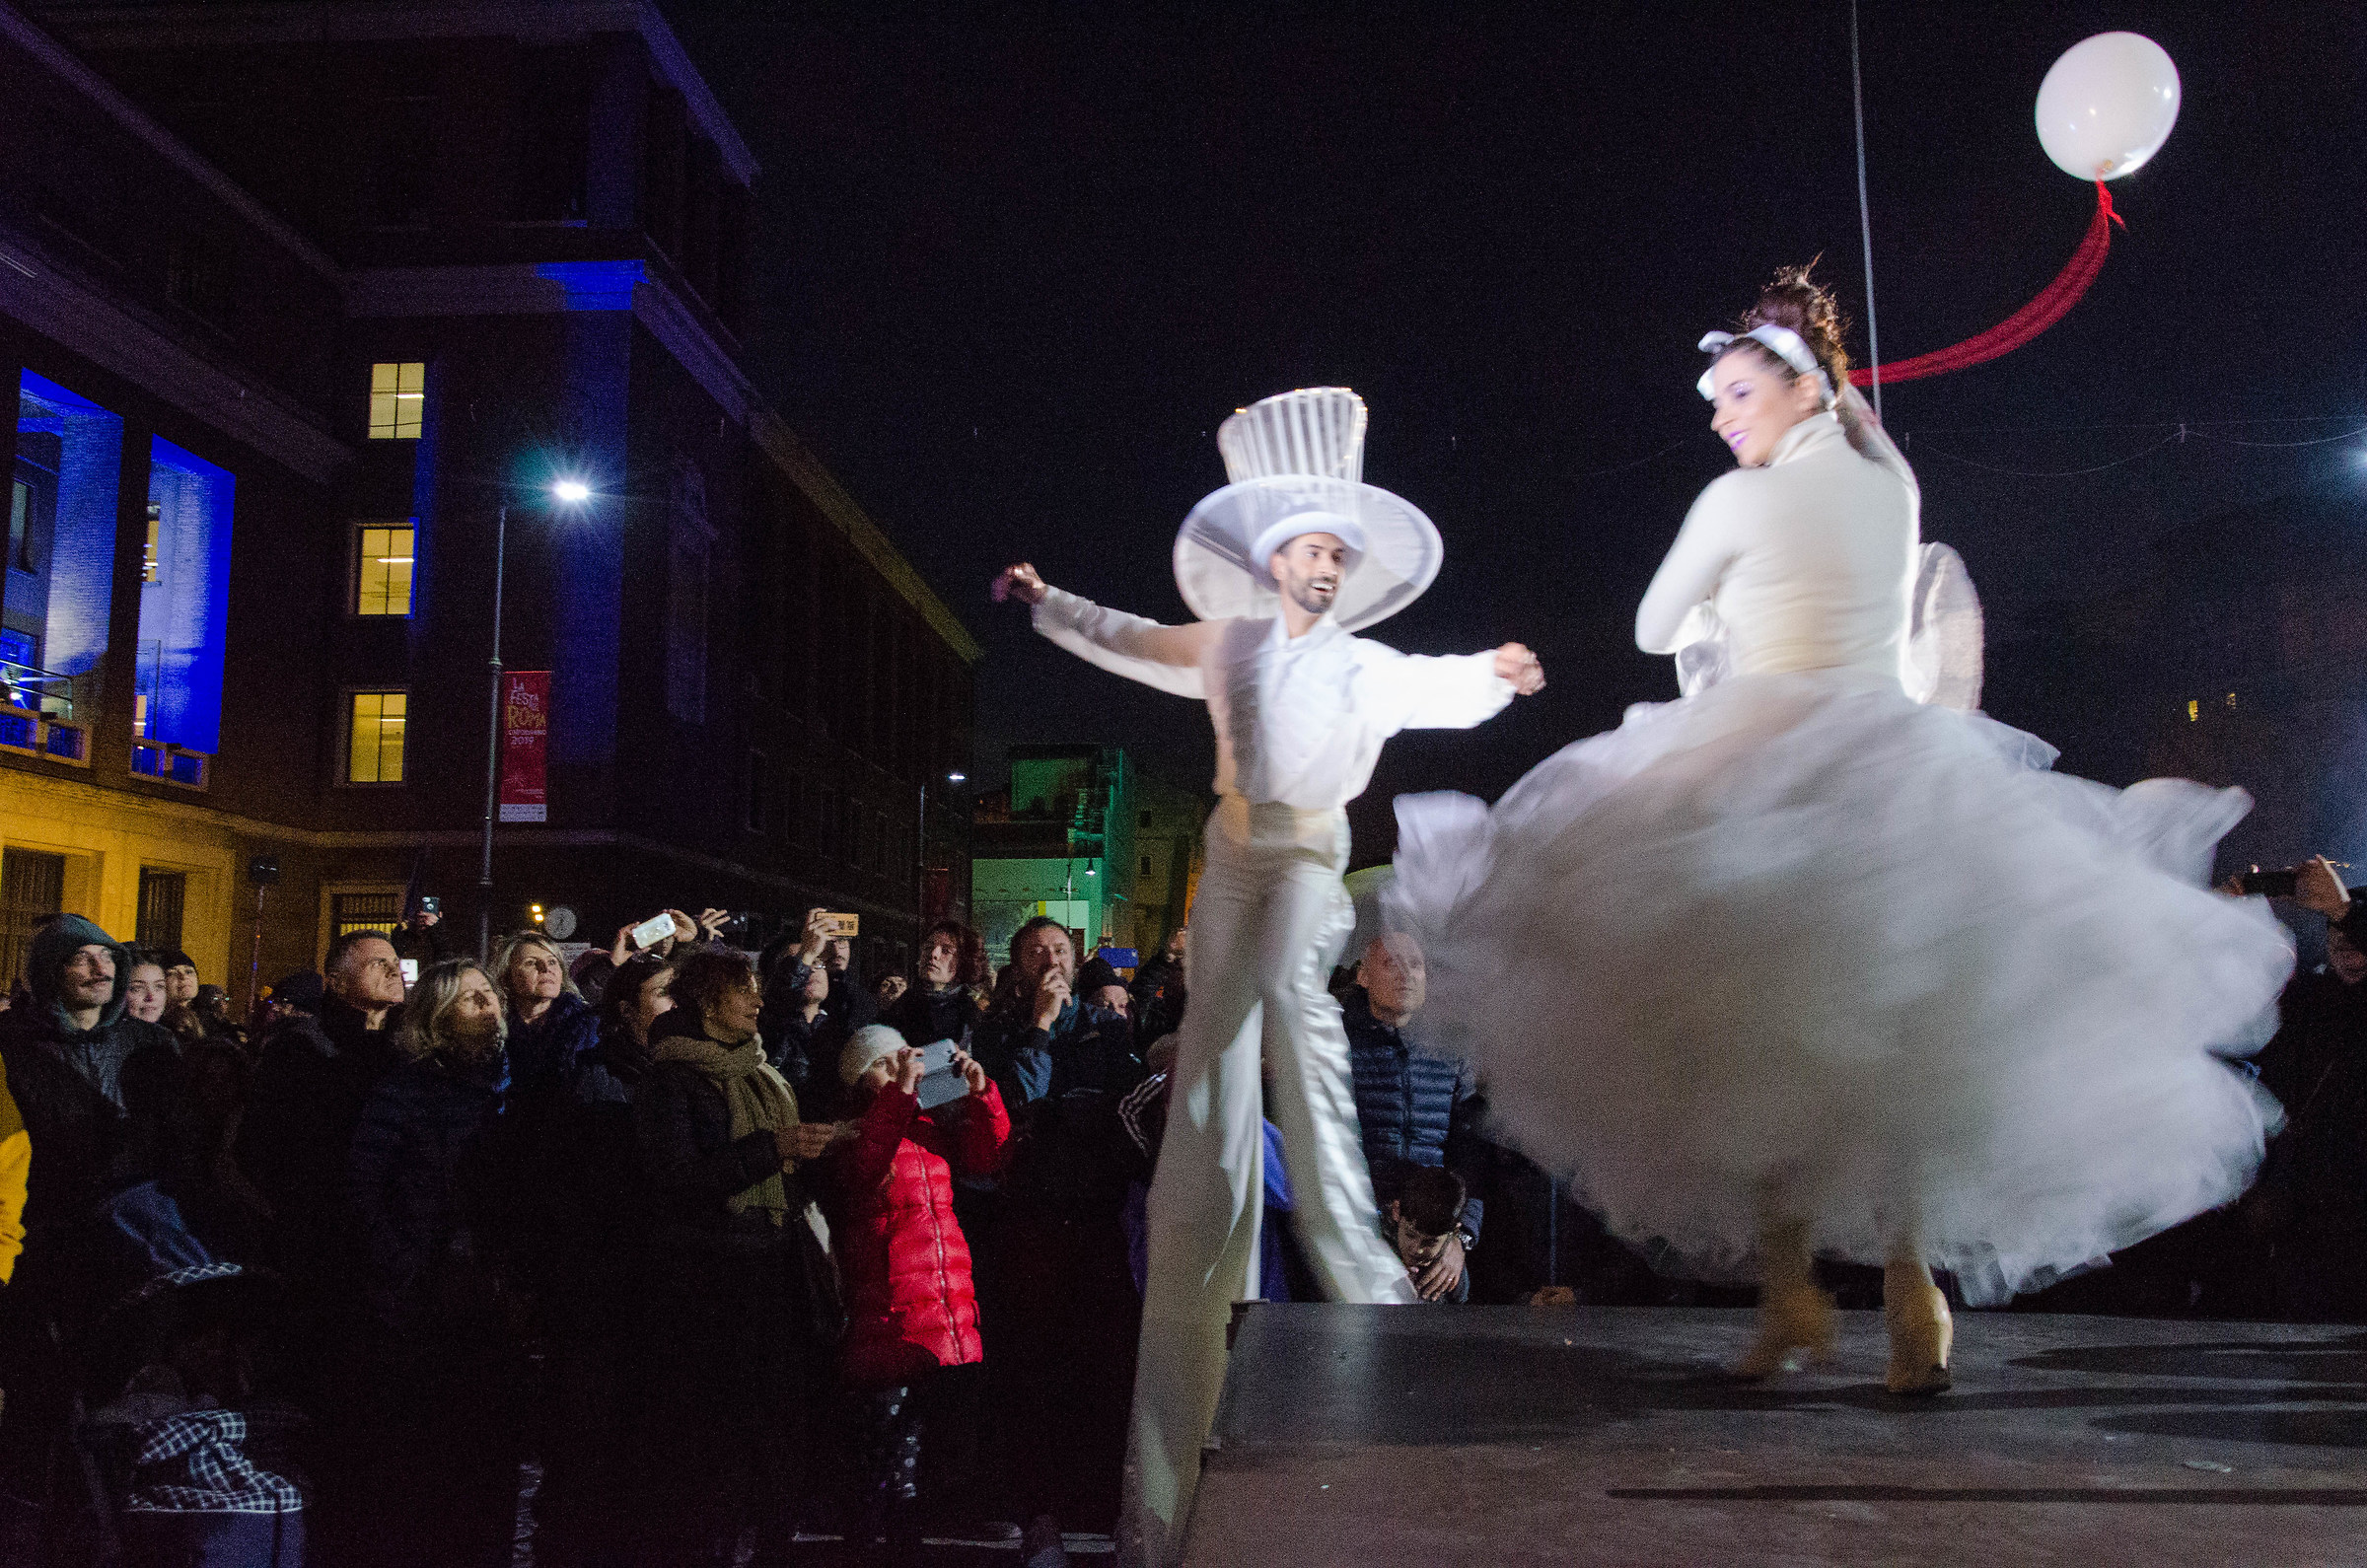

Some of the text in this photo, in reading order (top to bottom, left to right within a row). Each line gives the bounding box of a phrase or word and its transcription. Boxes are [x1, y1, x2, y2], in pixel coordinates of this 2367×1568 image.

[510, 689, 538, 707] FESTA
[508, 705, 546, 729] ROMA
[511, 737, 534, 746] 2019
